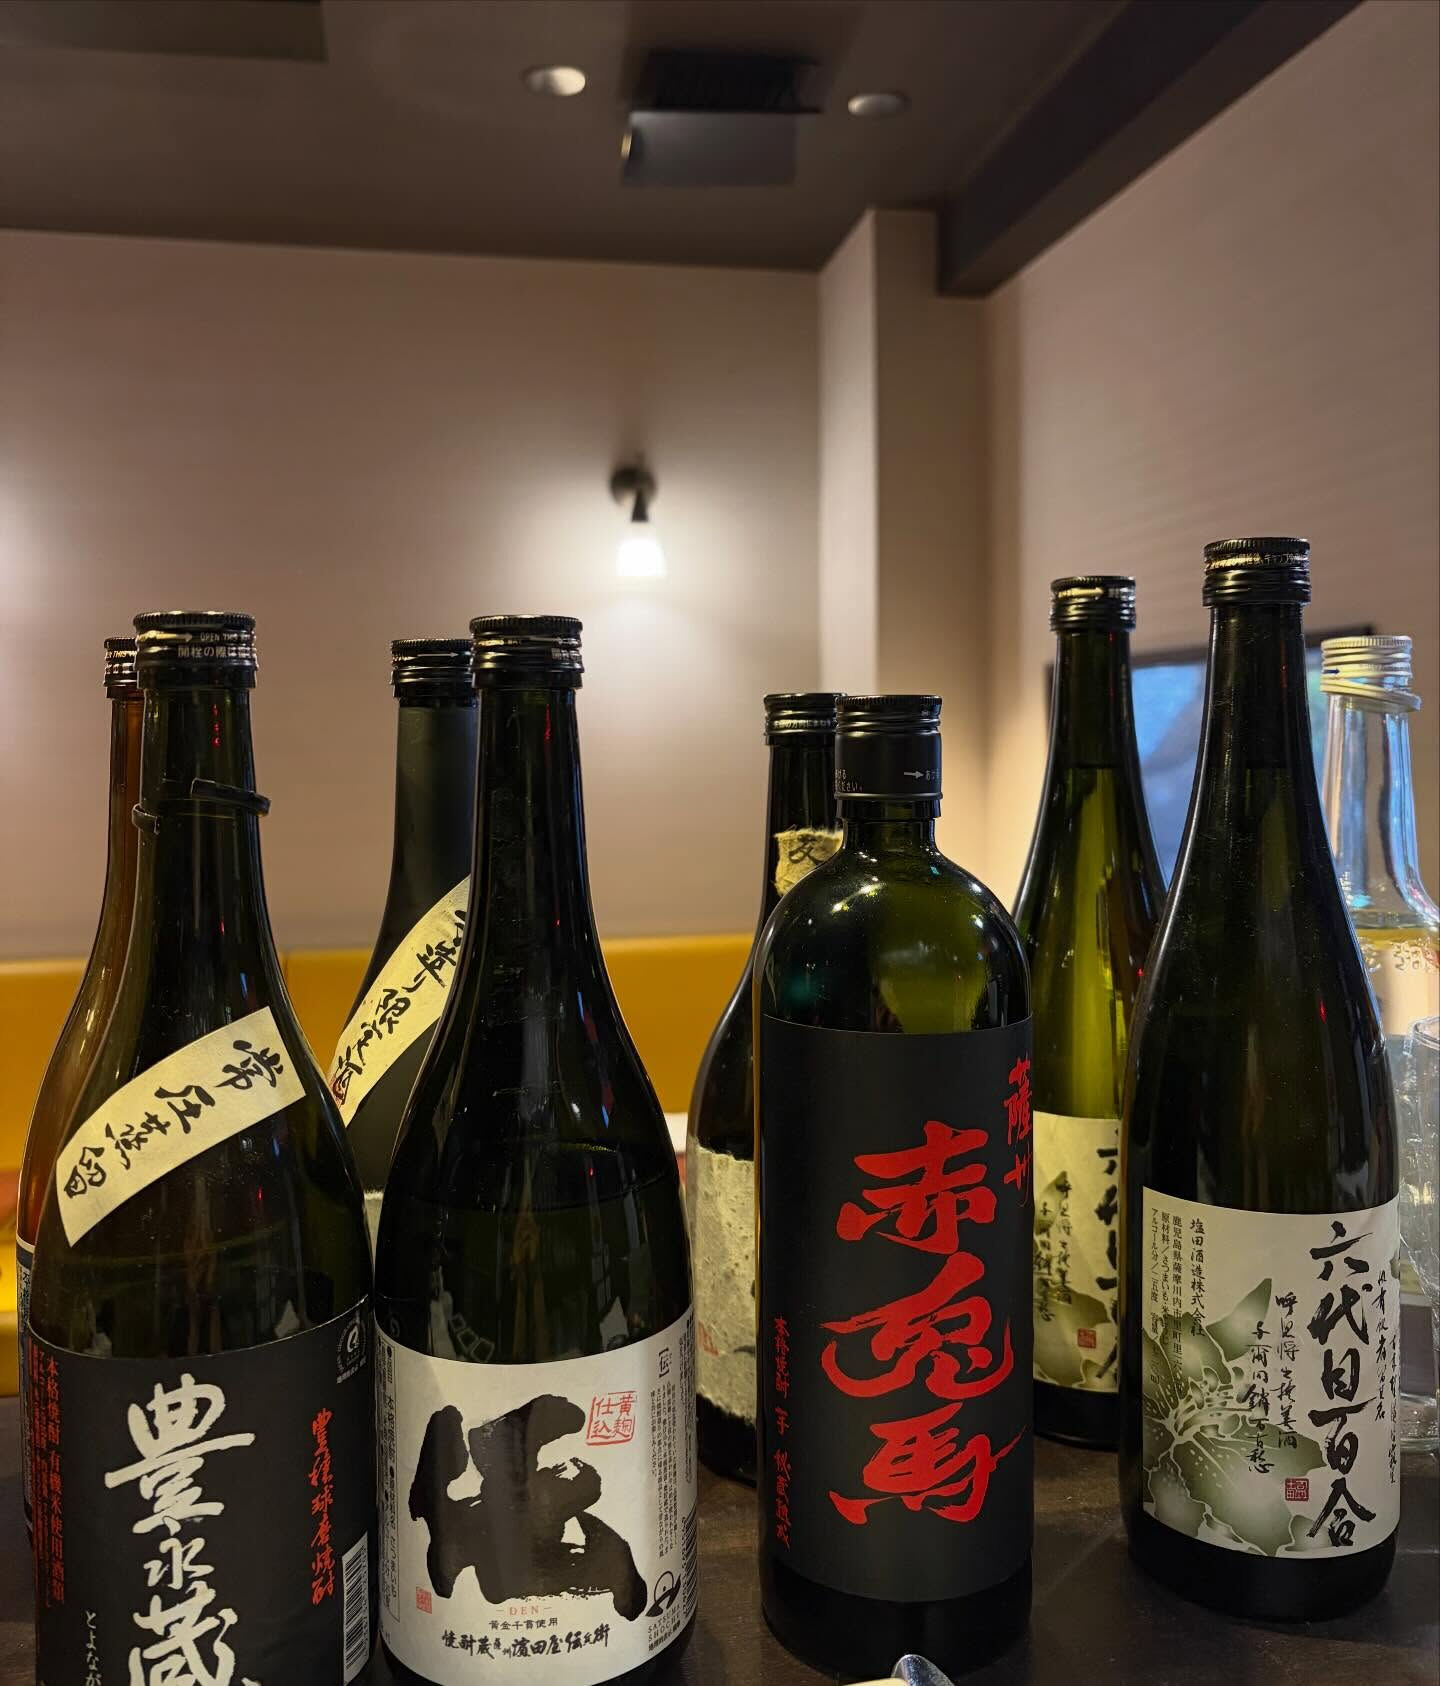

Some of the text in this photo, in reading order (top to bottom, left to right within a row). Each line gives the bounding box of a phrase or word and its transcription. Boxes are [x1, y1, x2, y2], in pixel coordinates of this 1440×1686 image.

[816, 1120, 1028, 1525] 赤兎馬
[1190, 1218, 1206, 1337] 塩田酒造株式会社
[1306, 1220, 1378, 1547] 六代目百合
[509, 1605, 540, 1616] DEN
